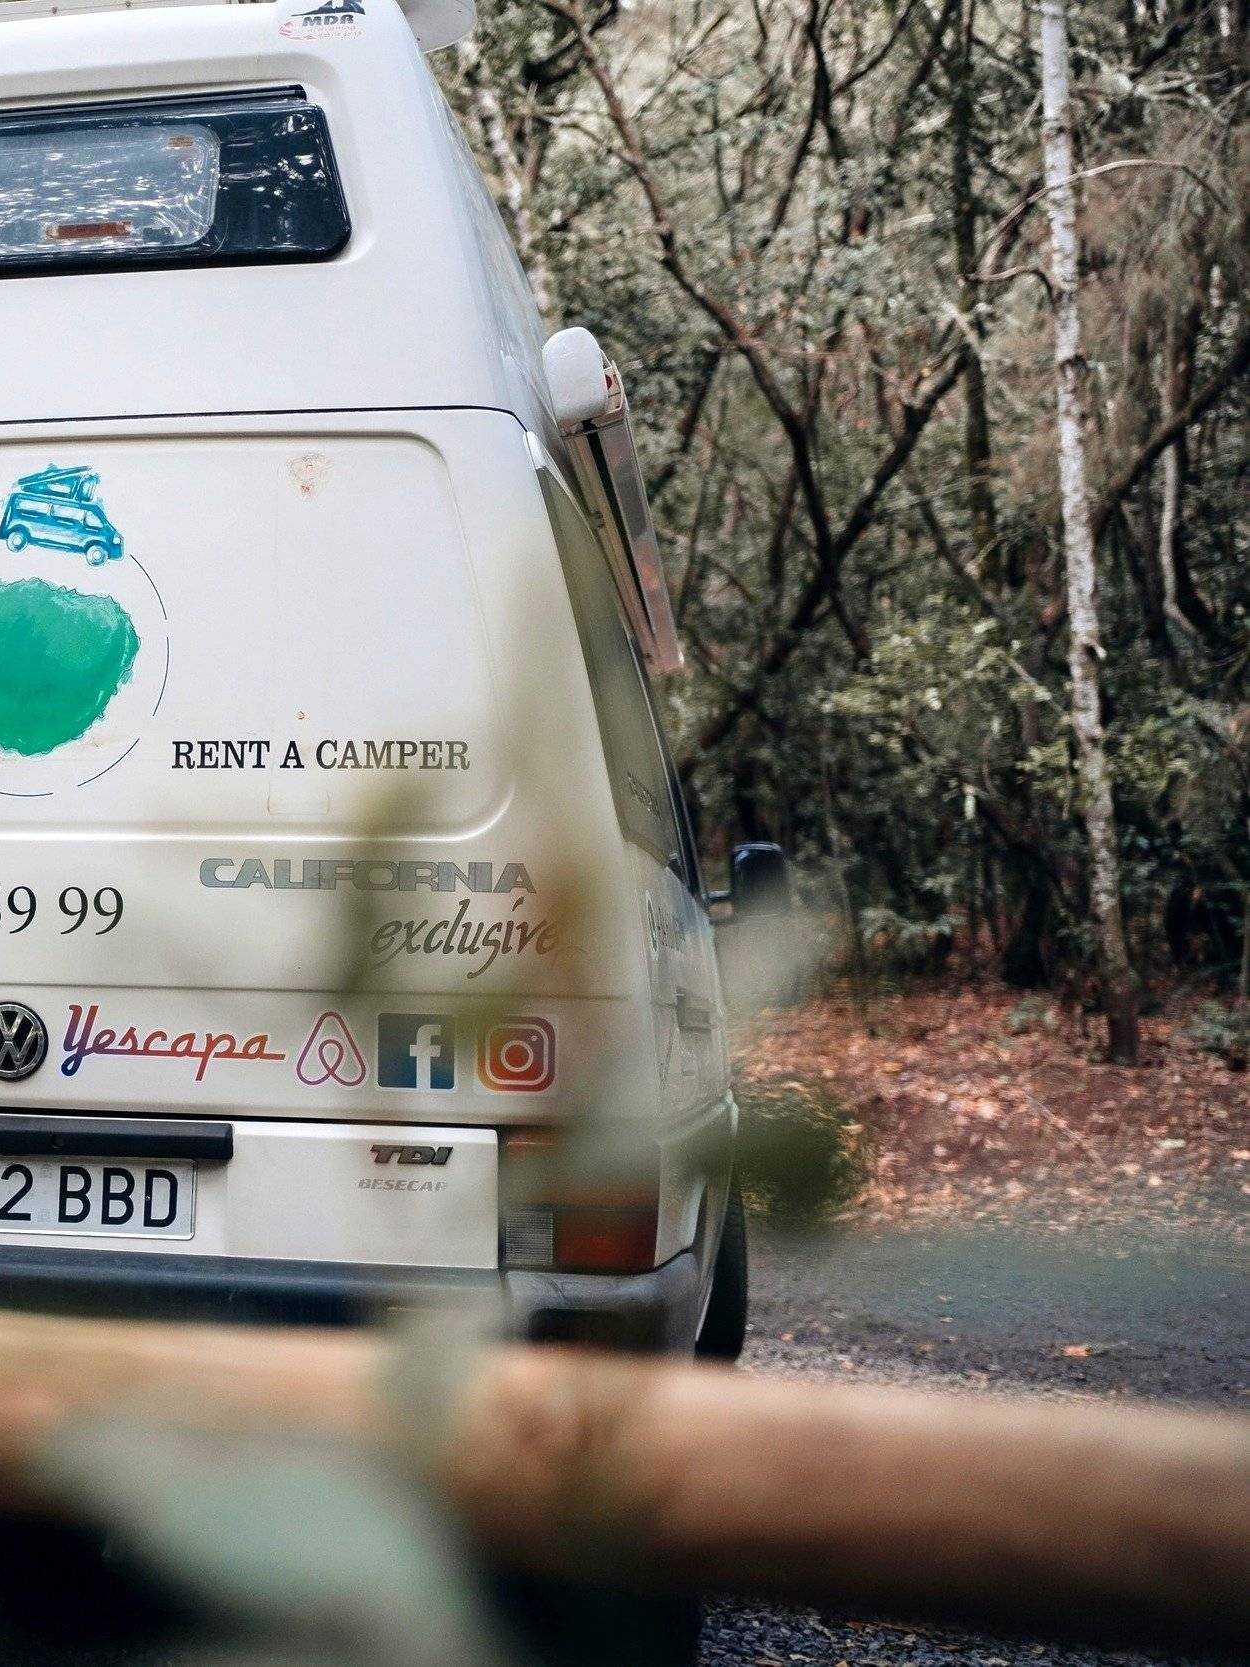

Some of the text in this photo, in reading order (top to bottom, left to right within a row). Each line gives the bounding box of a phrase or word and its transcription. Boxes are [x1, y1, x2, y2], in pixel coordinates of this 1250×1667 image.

[171, 740, 471, 771] RENT A CAMPER
[199, 857, 537, 894] CALIFORNIA
[58, 886, 124, 936] 99
[369, 896, 557, 979] exclusive
[61, 1003, 286, 1082] Yescapa
[370, 1144, 454, 1166] TDI
[58, 1166, 178, 1228] BBD
